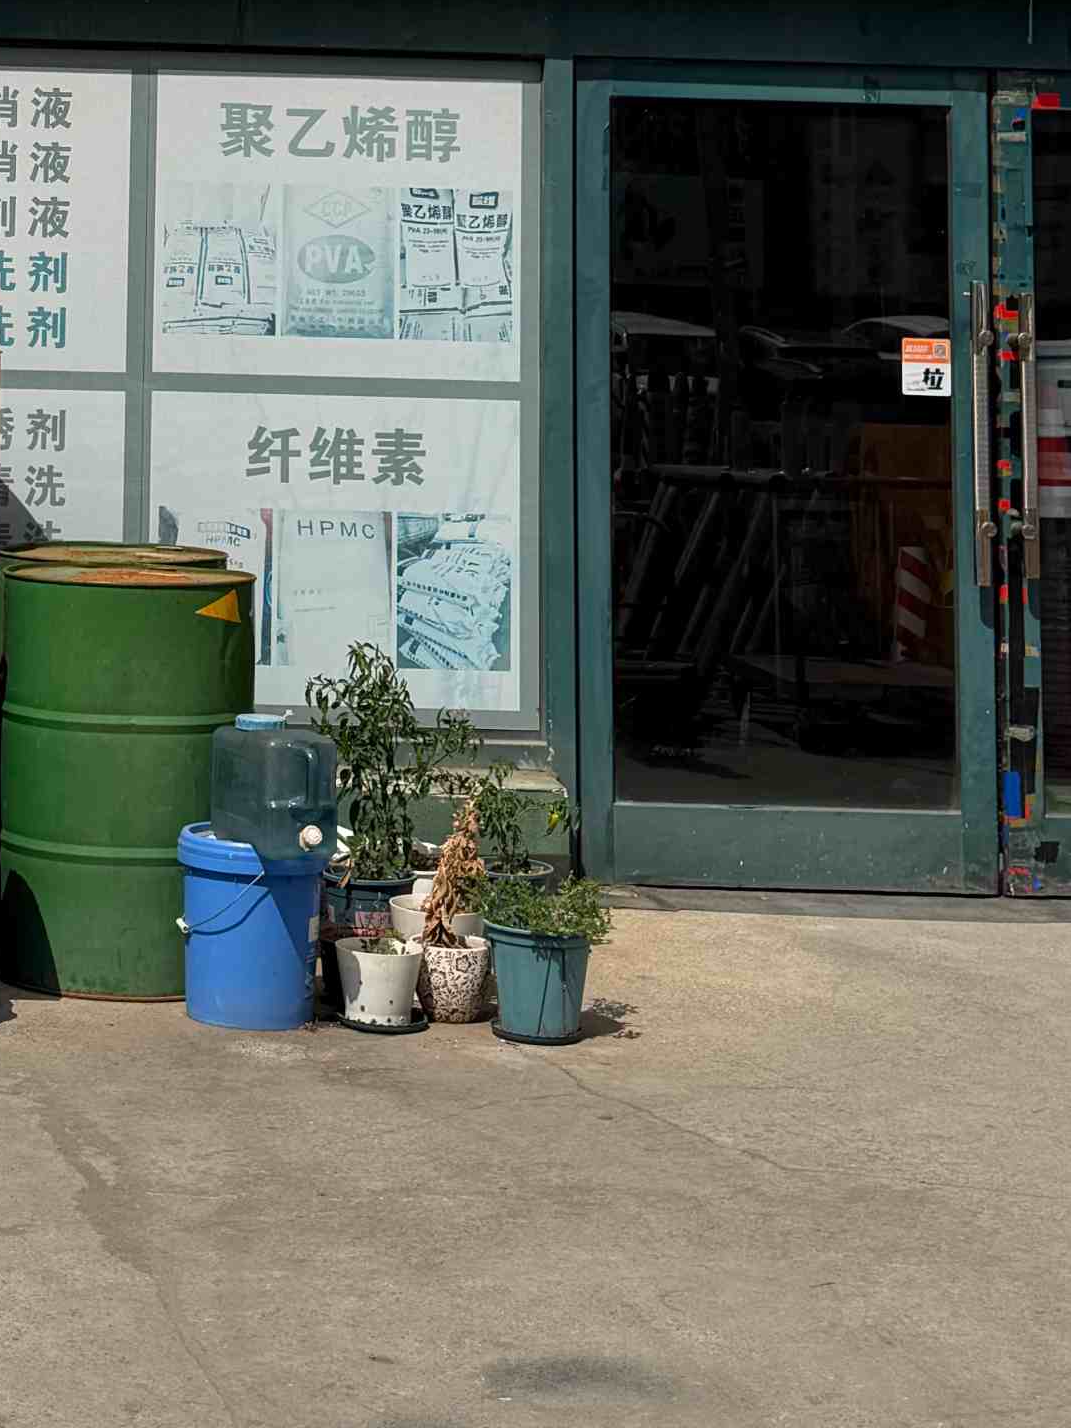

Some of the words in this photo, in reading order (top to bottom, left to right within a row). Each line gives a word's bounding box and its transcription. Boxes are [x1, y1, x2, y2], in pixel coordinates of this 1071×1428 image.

[219, 102, 461, 163] 聚乙烯醇
[304, 243, 365, 273] PVA
[922, 367, 945, 390] 拉
[245, 425, 427, 486] 纤维素
[297, 519, 378, 540] HPMC
